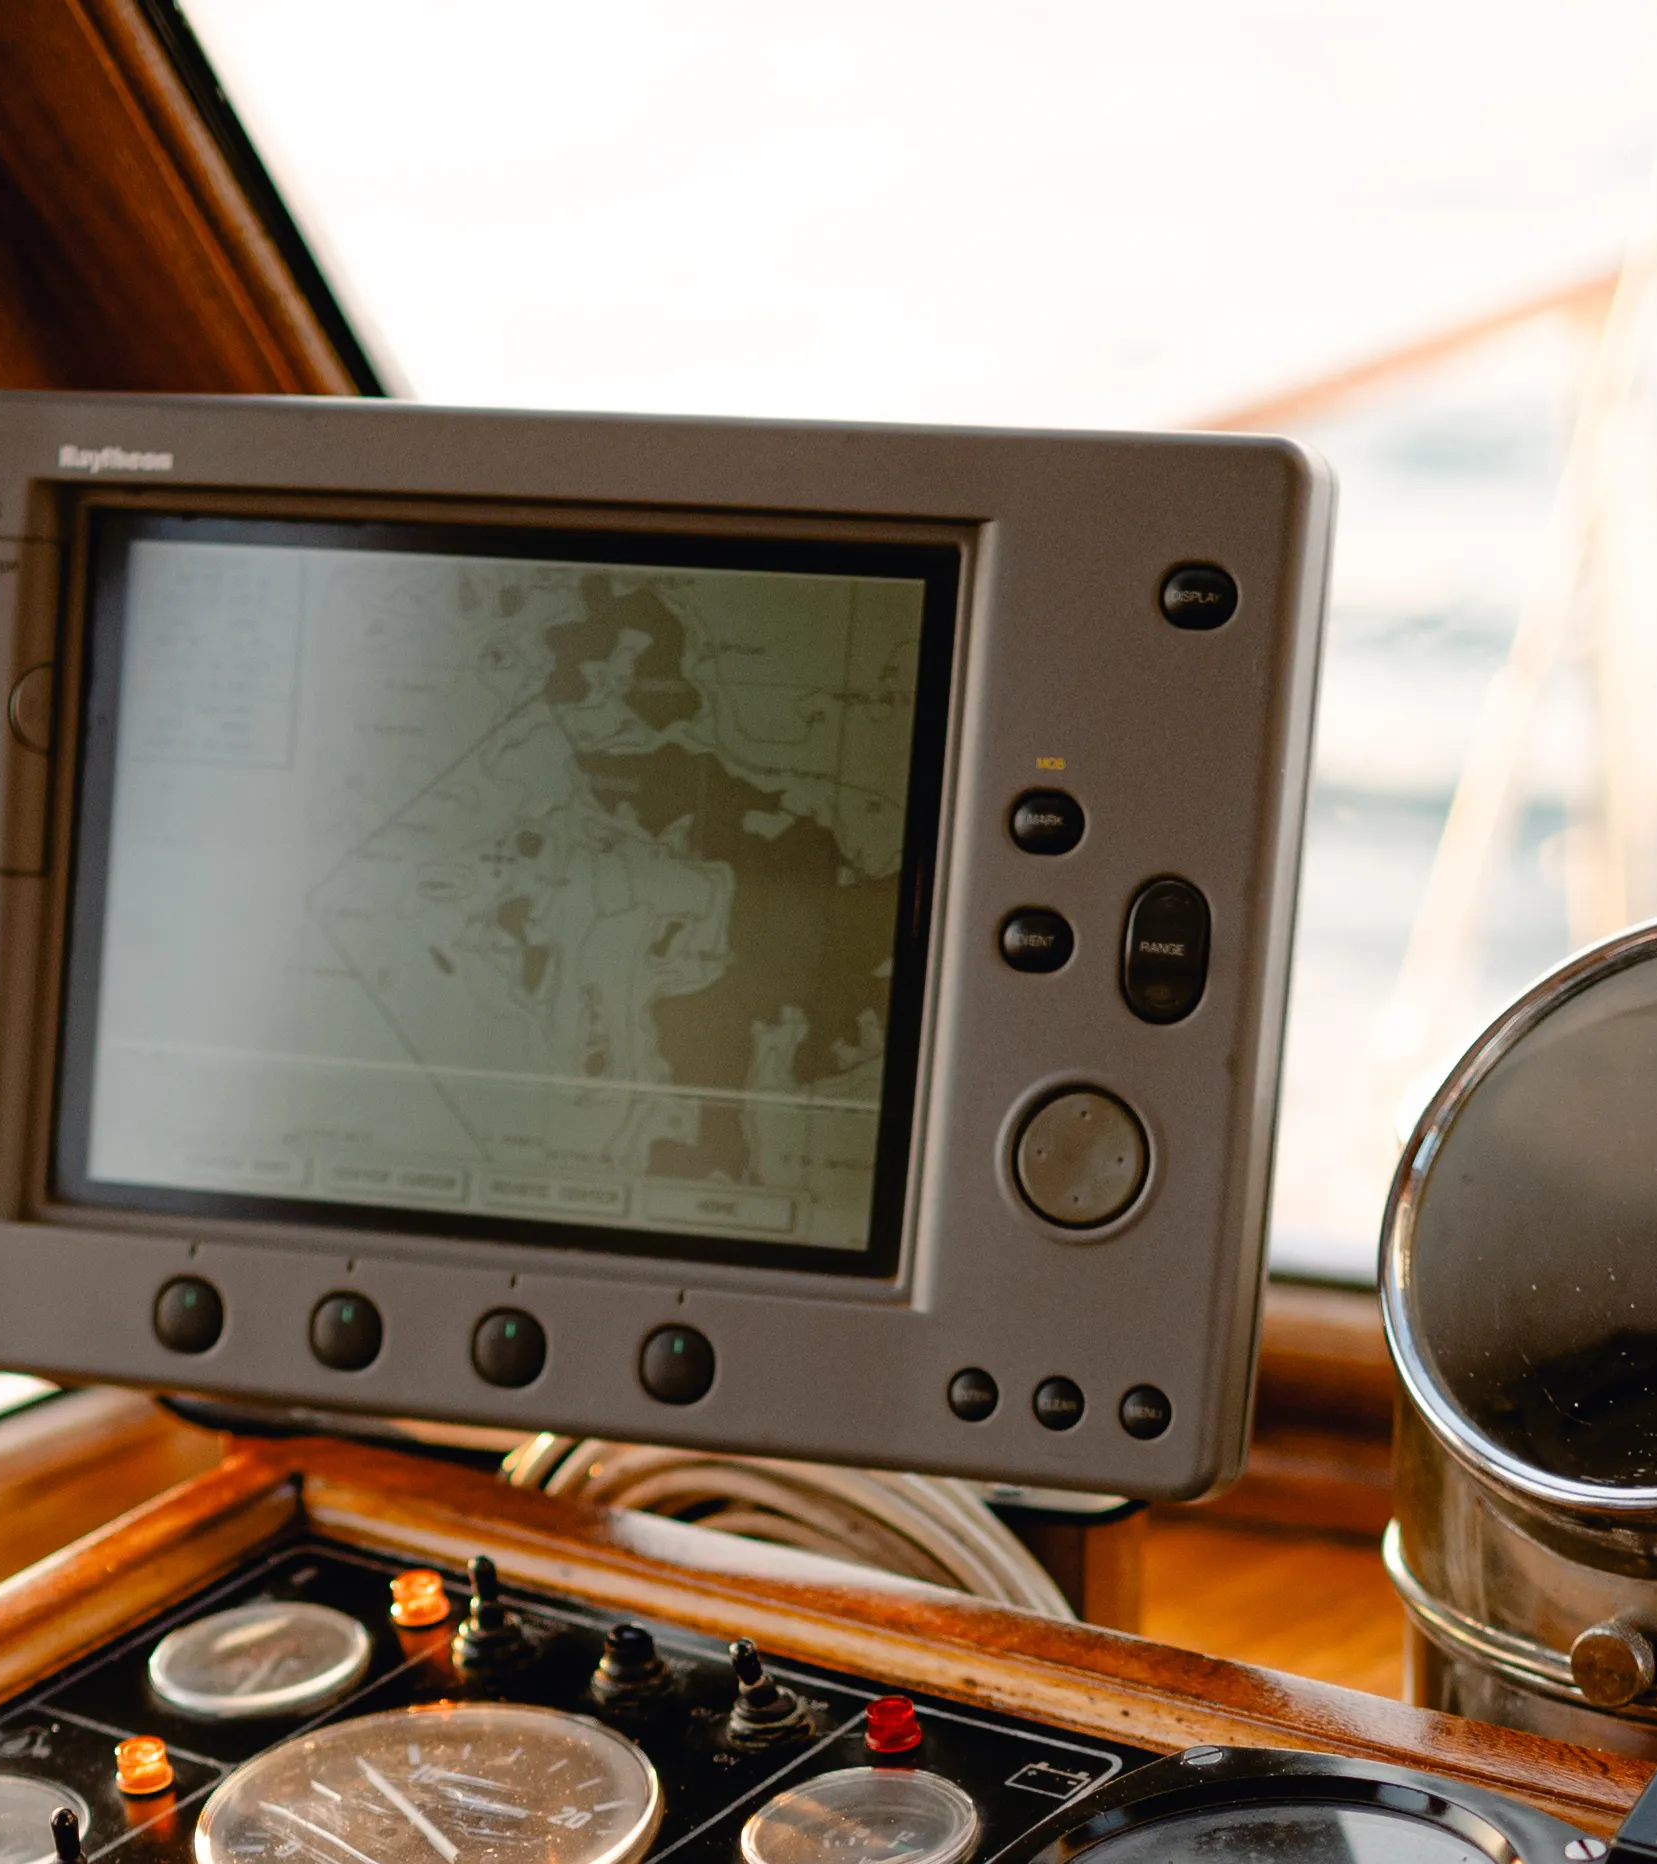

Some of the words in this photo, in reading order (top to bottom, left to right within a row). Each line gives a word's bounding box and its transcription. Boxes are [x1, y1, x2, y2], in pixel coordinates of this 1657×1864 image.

[1172, 590, 1222, 604] DISPLAY
[1139, 940, 1185, 956] RANGE
[547, 1806, 592, 1830] 20
